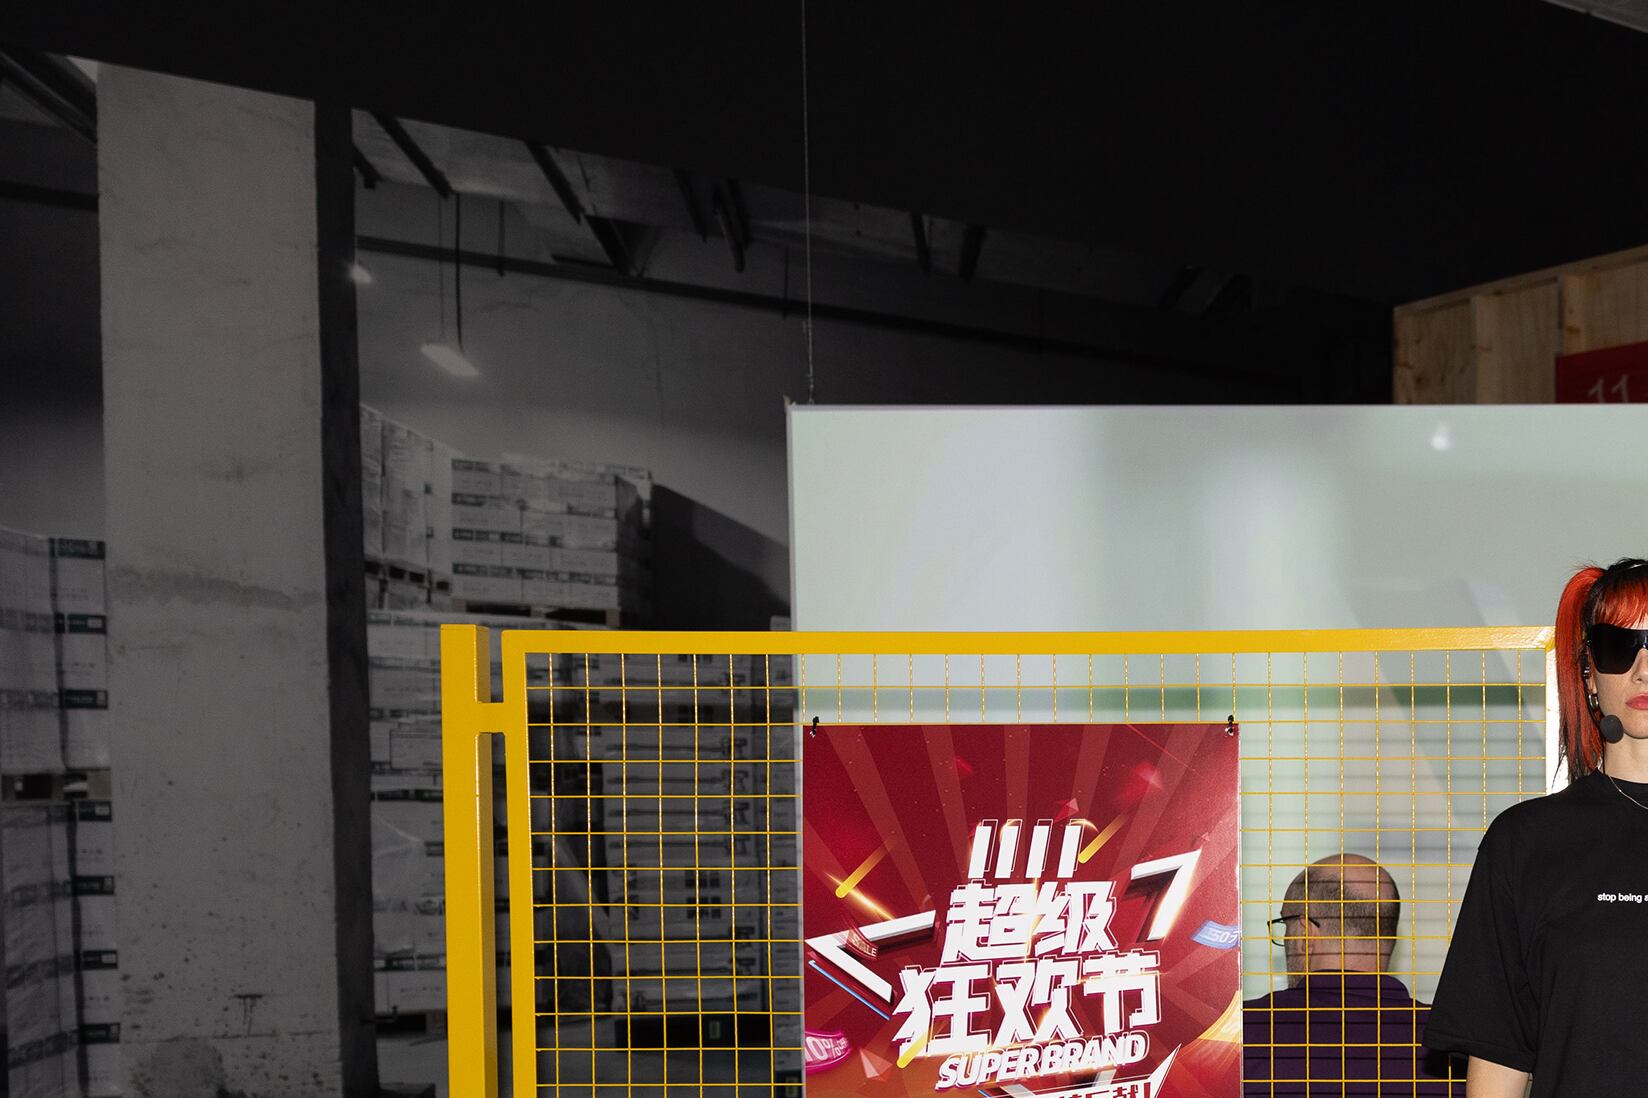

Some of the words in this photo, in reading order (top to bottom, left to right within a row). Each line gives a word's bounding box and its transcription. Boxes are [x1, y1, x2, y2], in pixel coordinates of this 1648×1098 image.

[940, 879, 1118, 964] 超级
[1597, 893, 1616, 903] stop
[1618, 893, 1642, 903] being
[892, 950, 1161, 1057] 狂欢节
